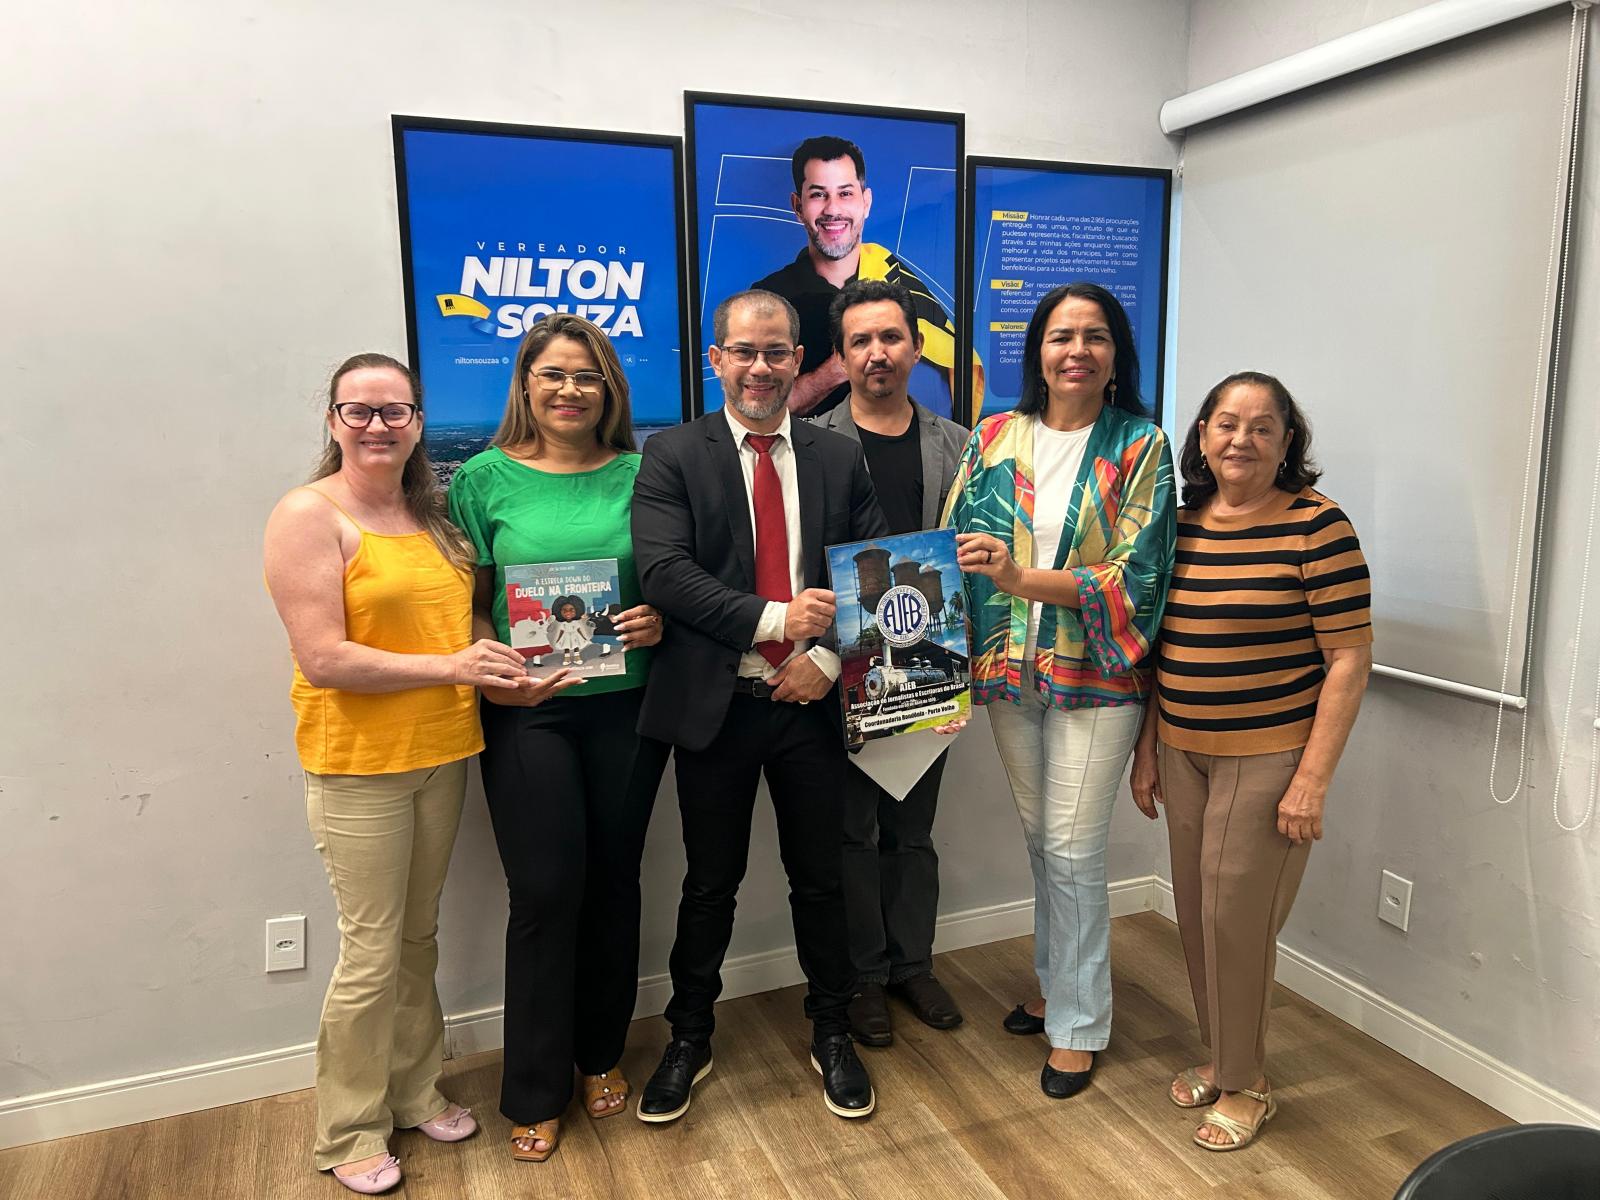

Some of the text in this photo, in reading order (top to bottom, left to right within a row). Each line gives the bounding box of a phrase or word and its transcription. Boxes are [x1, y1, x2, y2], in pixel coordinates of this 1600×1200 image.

[1106, 218, 1139, 226] procurações
[1112, 234, 1138, 242] buscando
[477, 241, 626, 255] VEREADOR
[1034, 256, 1058, 264] projetos
[460, 255, 645, 300] NILTON
[565, 575, 582, 584] DOWN
[515, 580, 612, 598] DUELO NA FRONTEIRA
[884, 593, 922, 636] AJEB
[900, 680, 916, 692] AJEB
[850, 699, 880, 710] Associação
[950, 682, 964, 690] Brasil
[864, 714, 902, 728] Coordenadoria
[902, 710, 924, 720] Rondônia
[928, 706, 941, 715] Porto
[941, 704, 956, 712] Velho
